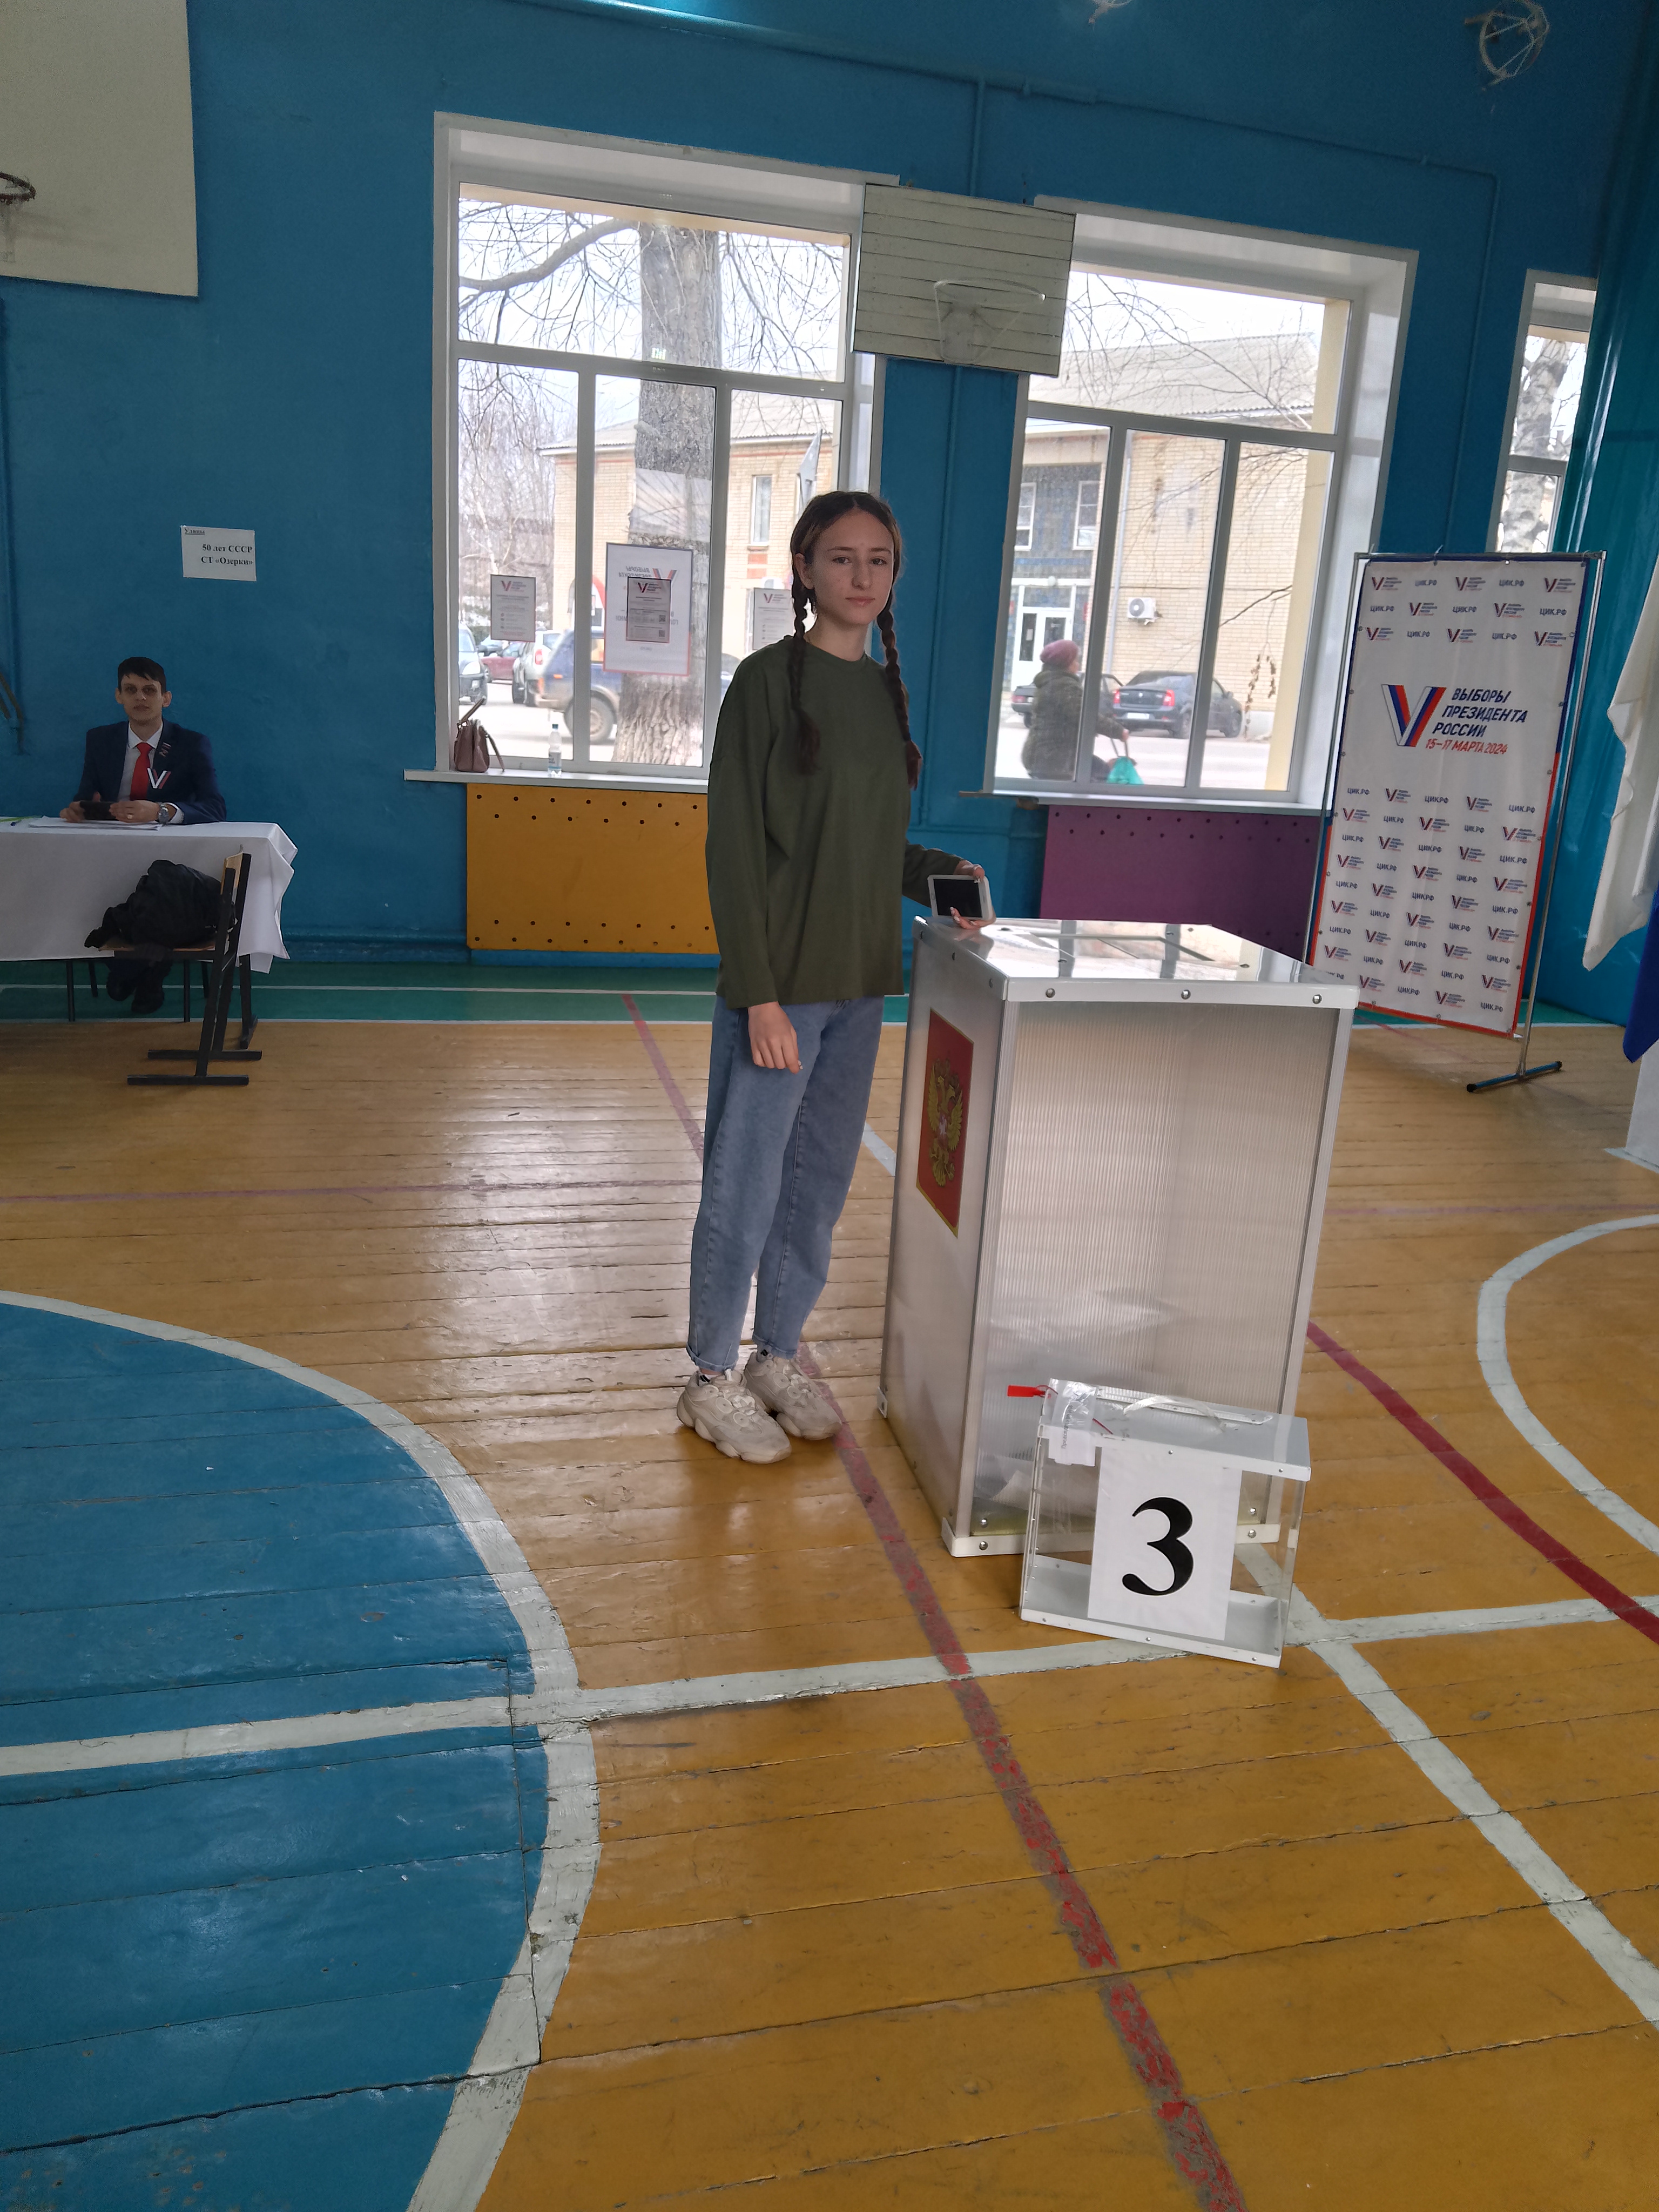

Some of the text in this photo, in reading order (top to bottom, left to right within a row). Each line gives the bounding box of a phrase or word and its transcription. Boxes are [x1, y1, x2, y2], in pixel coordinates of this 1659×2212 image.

[228, 545, 253, 553] СССР
[201, 556, 253, 566] СТ «Озерки»
[1452, 688, 1512, 703] ВЫБОРЫ
[1441, 705, 1528, 723] ПРЕЗИДЕНТА
[1432, 722, 1487, 738] РОССИИ
[1451, 740, 1484, 753] МАРТА
[1484, 743, 1508, 754] 2024
[1122, 1496, 1194, 1596] 3
